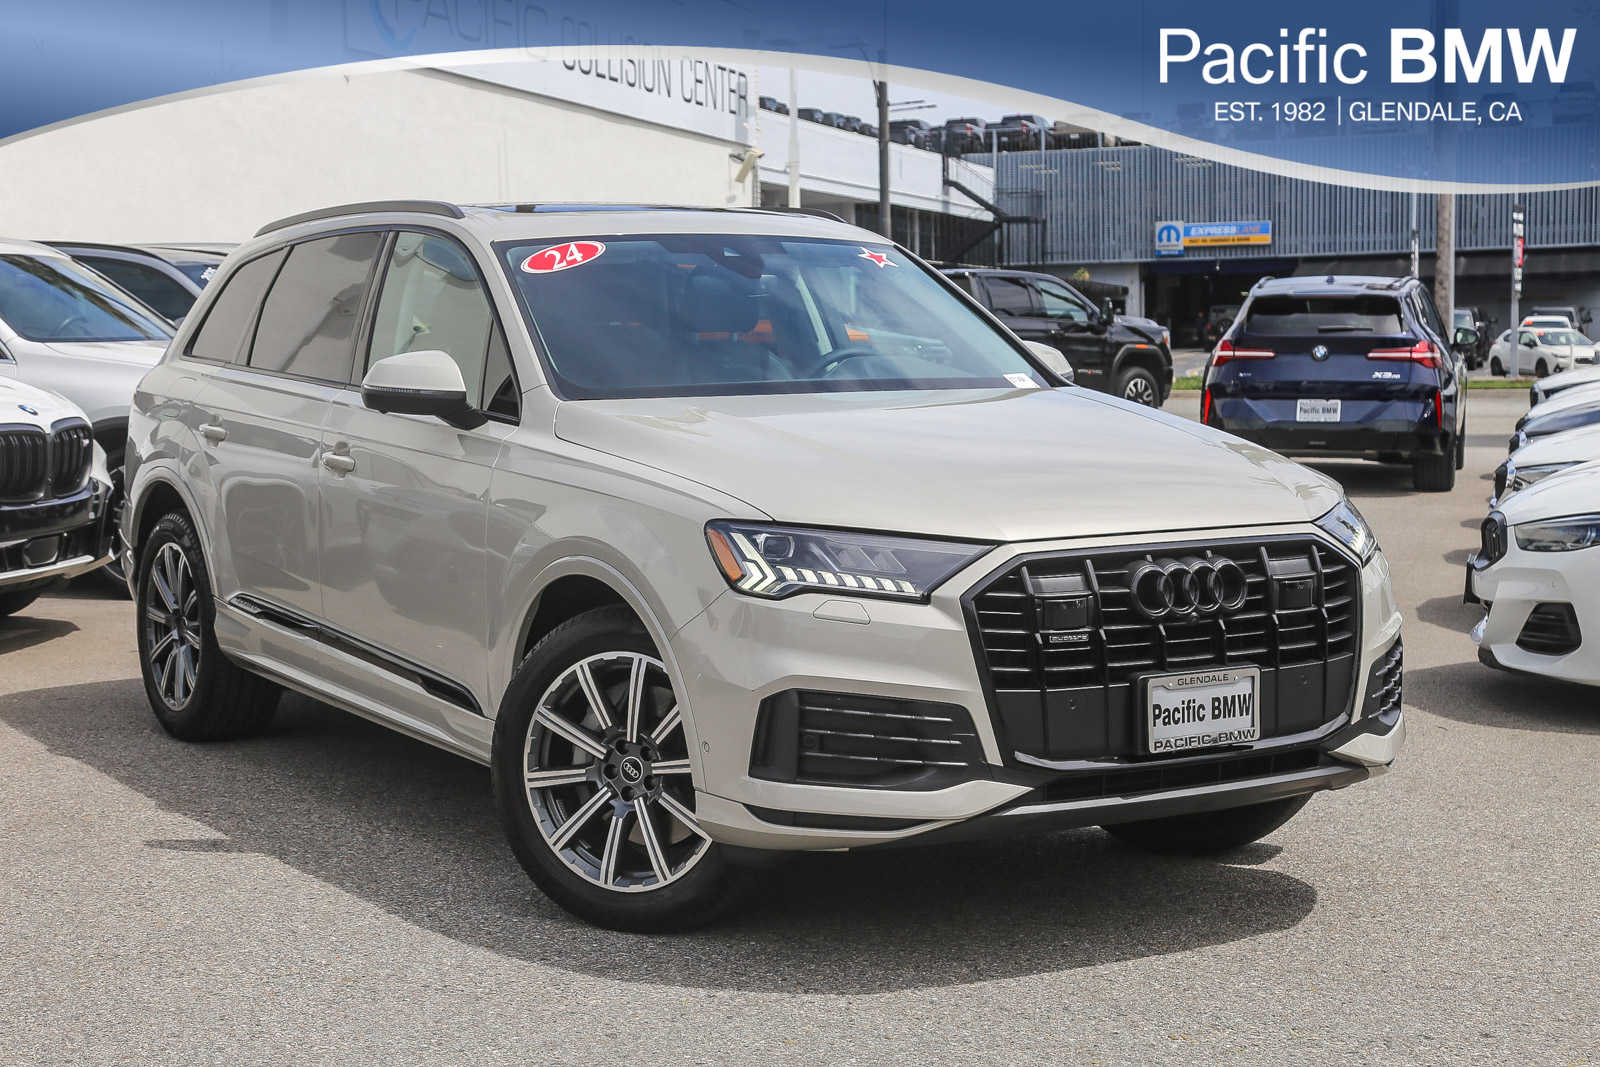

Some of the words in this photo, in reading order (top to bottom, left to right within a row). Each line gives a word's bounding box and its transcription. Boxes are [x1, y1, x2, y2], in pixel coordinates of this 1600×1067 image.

[680, 56, 749, 119] CENTER
[544, 243, 584, 270] 24
[1177, 673, 1229, 686] GLENDALE
[1152, 698, 1206, 727] Pacific
[1211, 693, 1252, 720] BMW
[1153, 734, 1212, 752] PACIFIC
[1218, 728, 1256, 744] BMW
